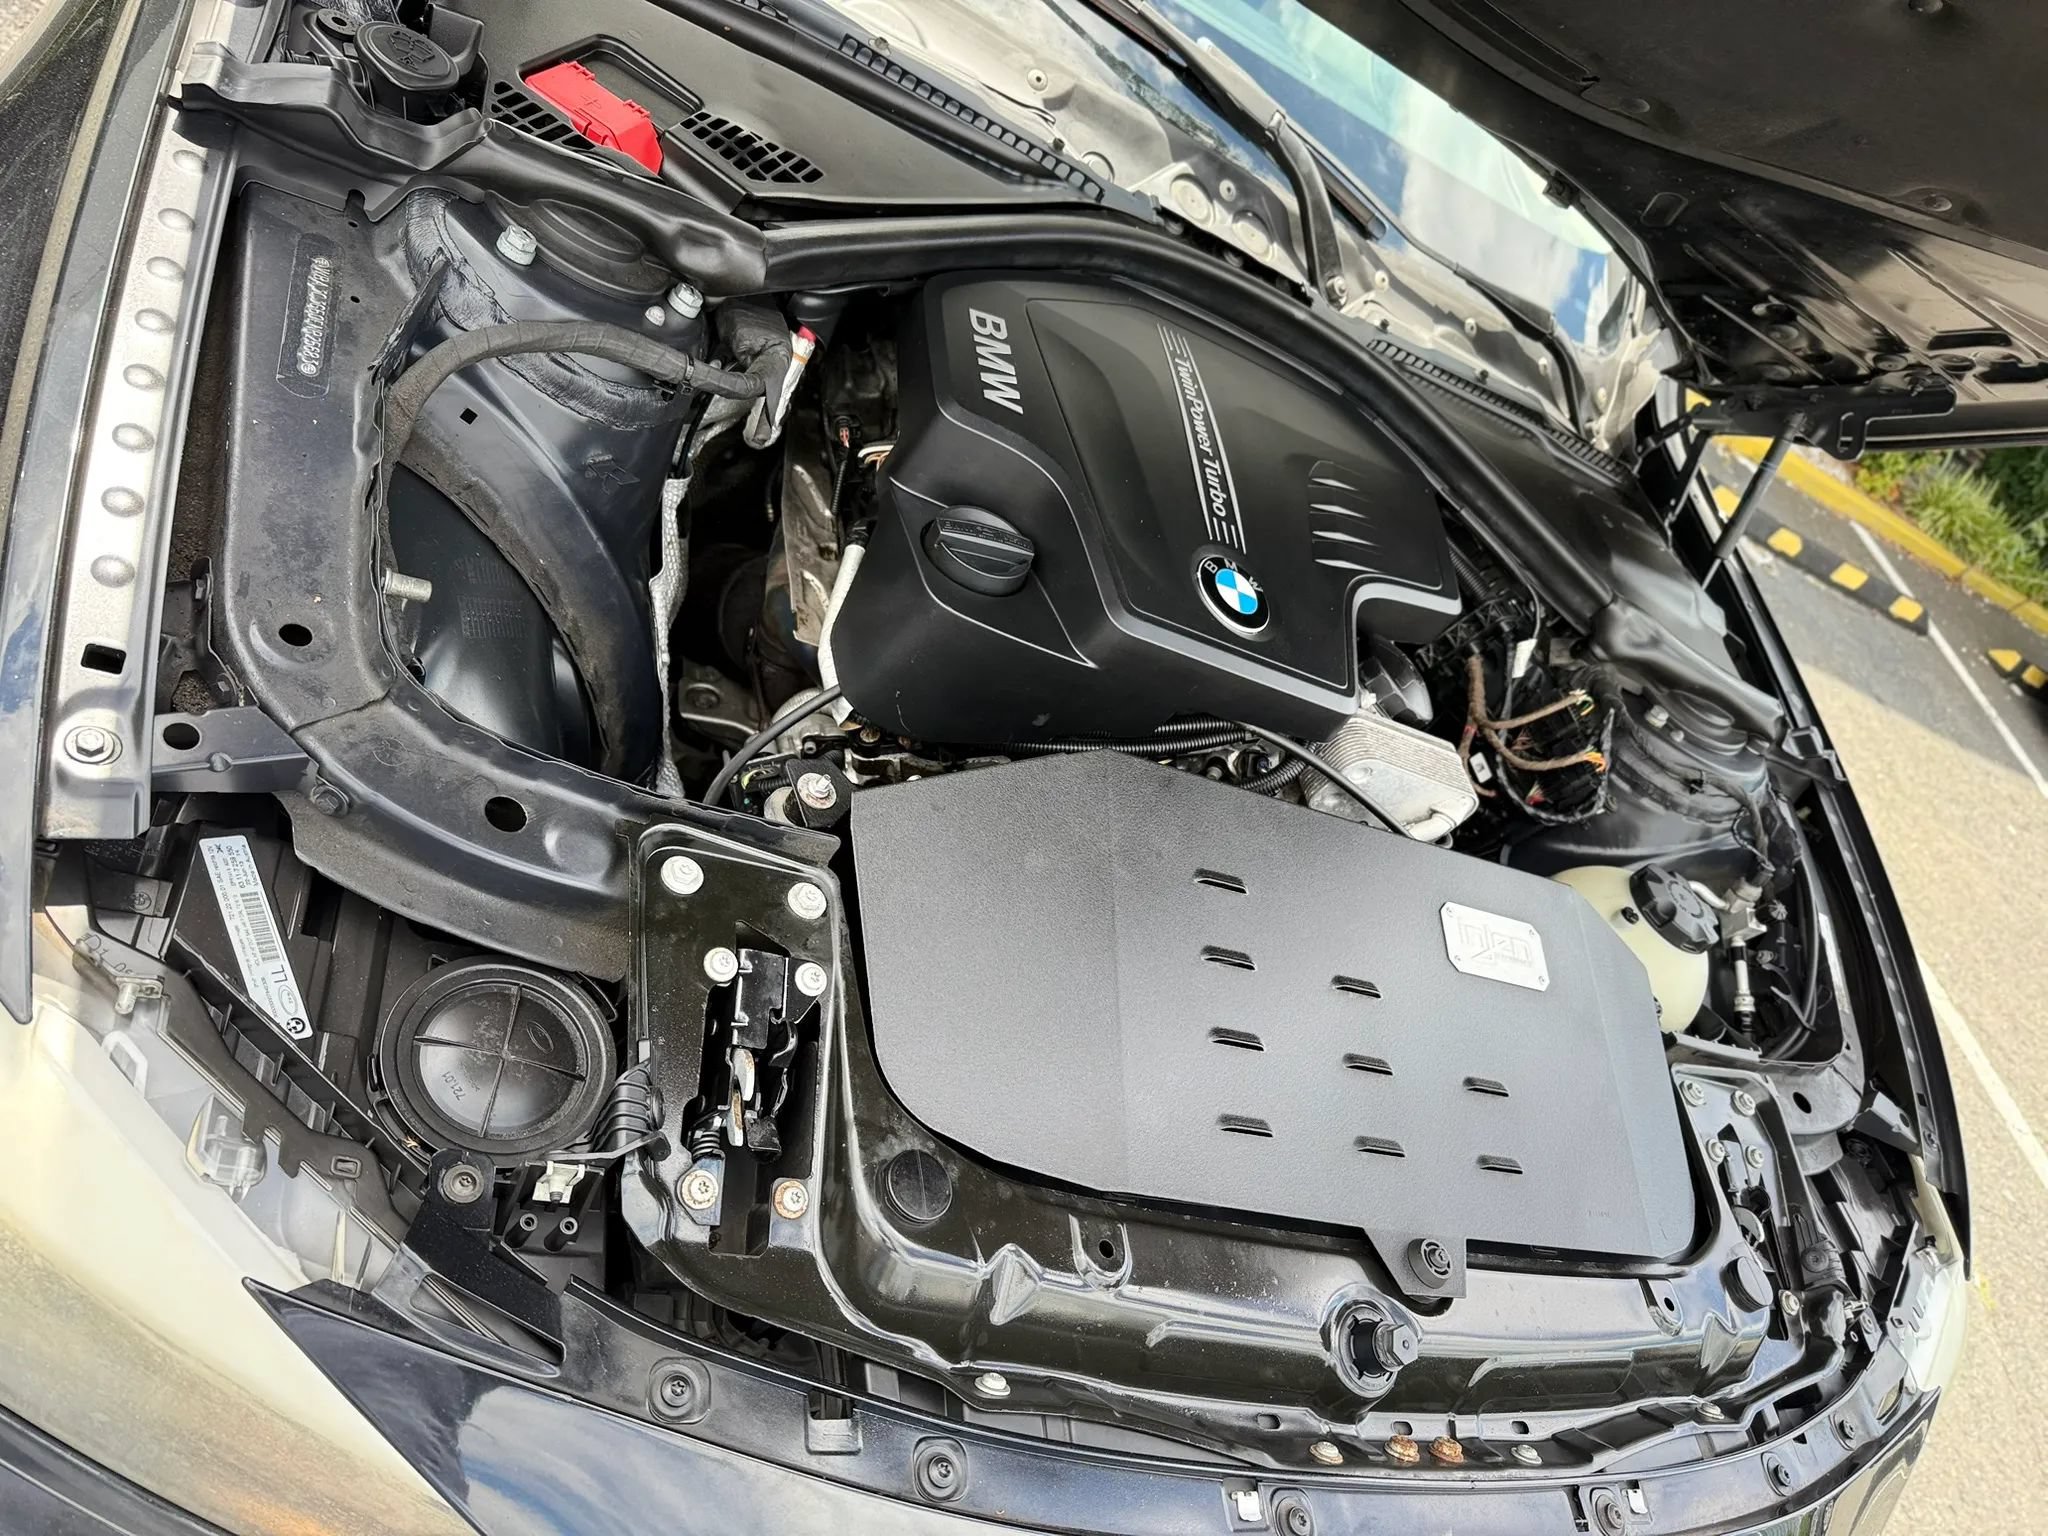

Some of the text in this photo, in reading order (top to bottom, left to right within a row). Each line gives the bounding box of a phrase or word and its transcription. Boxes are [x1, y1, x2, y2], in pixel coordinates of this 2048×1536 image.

[968, 307, 1024, 415] BMW
[1174, 357, 1227, 517] TwinPower Turbo
[1204, 558, 1263, 592] BMW
[271, 964, 288, 984] LL
[441, 1071, 466, 1101] 721.01
